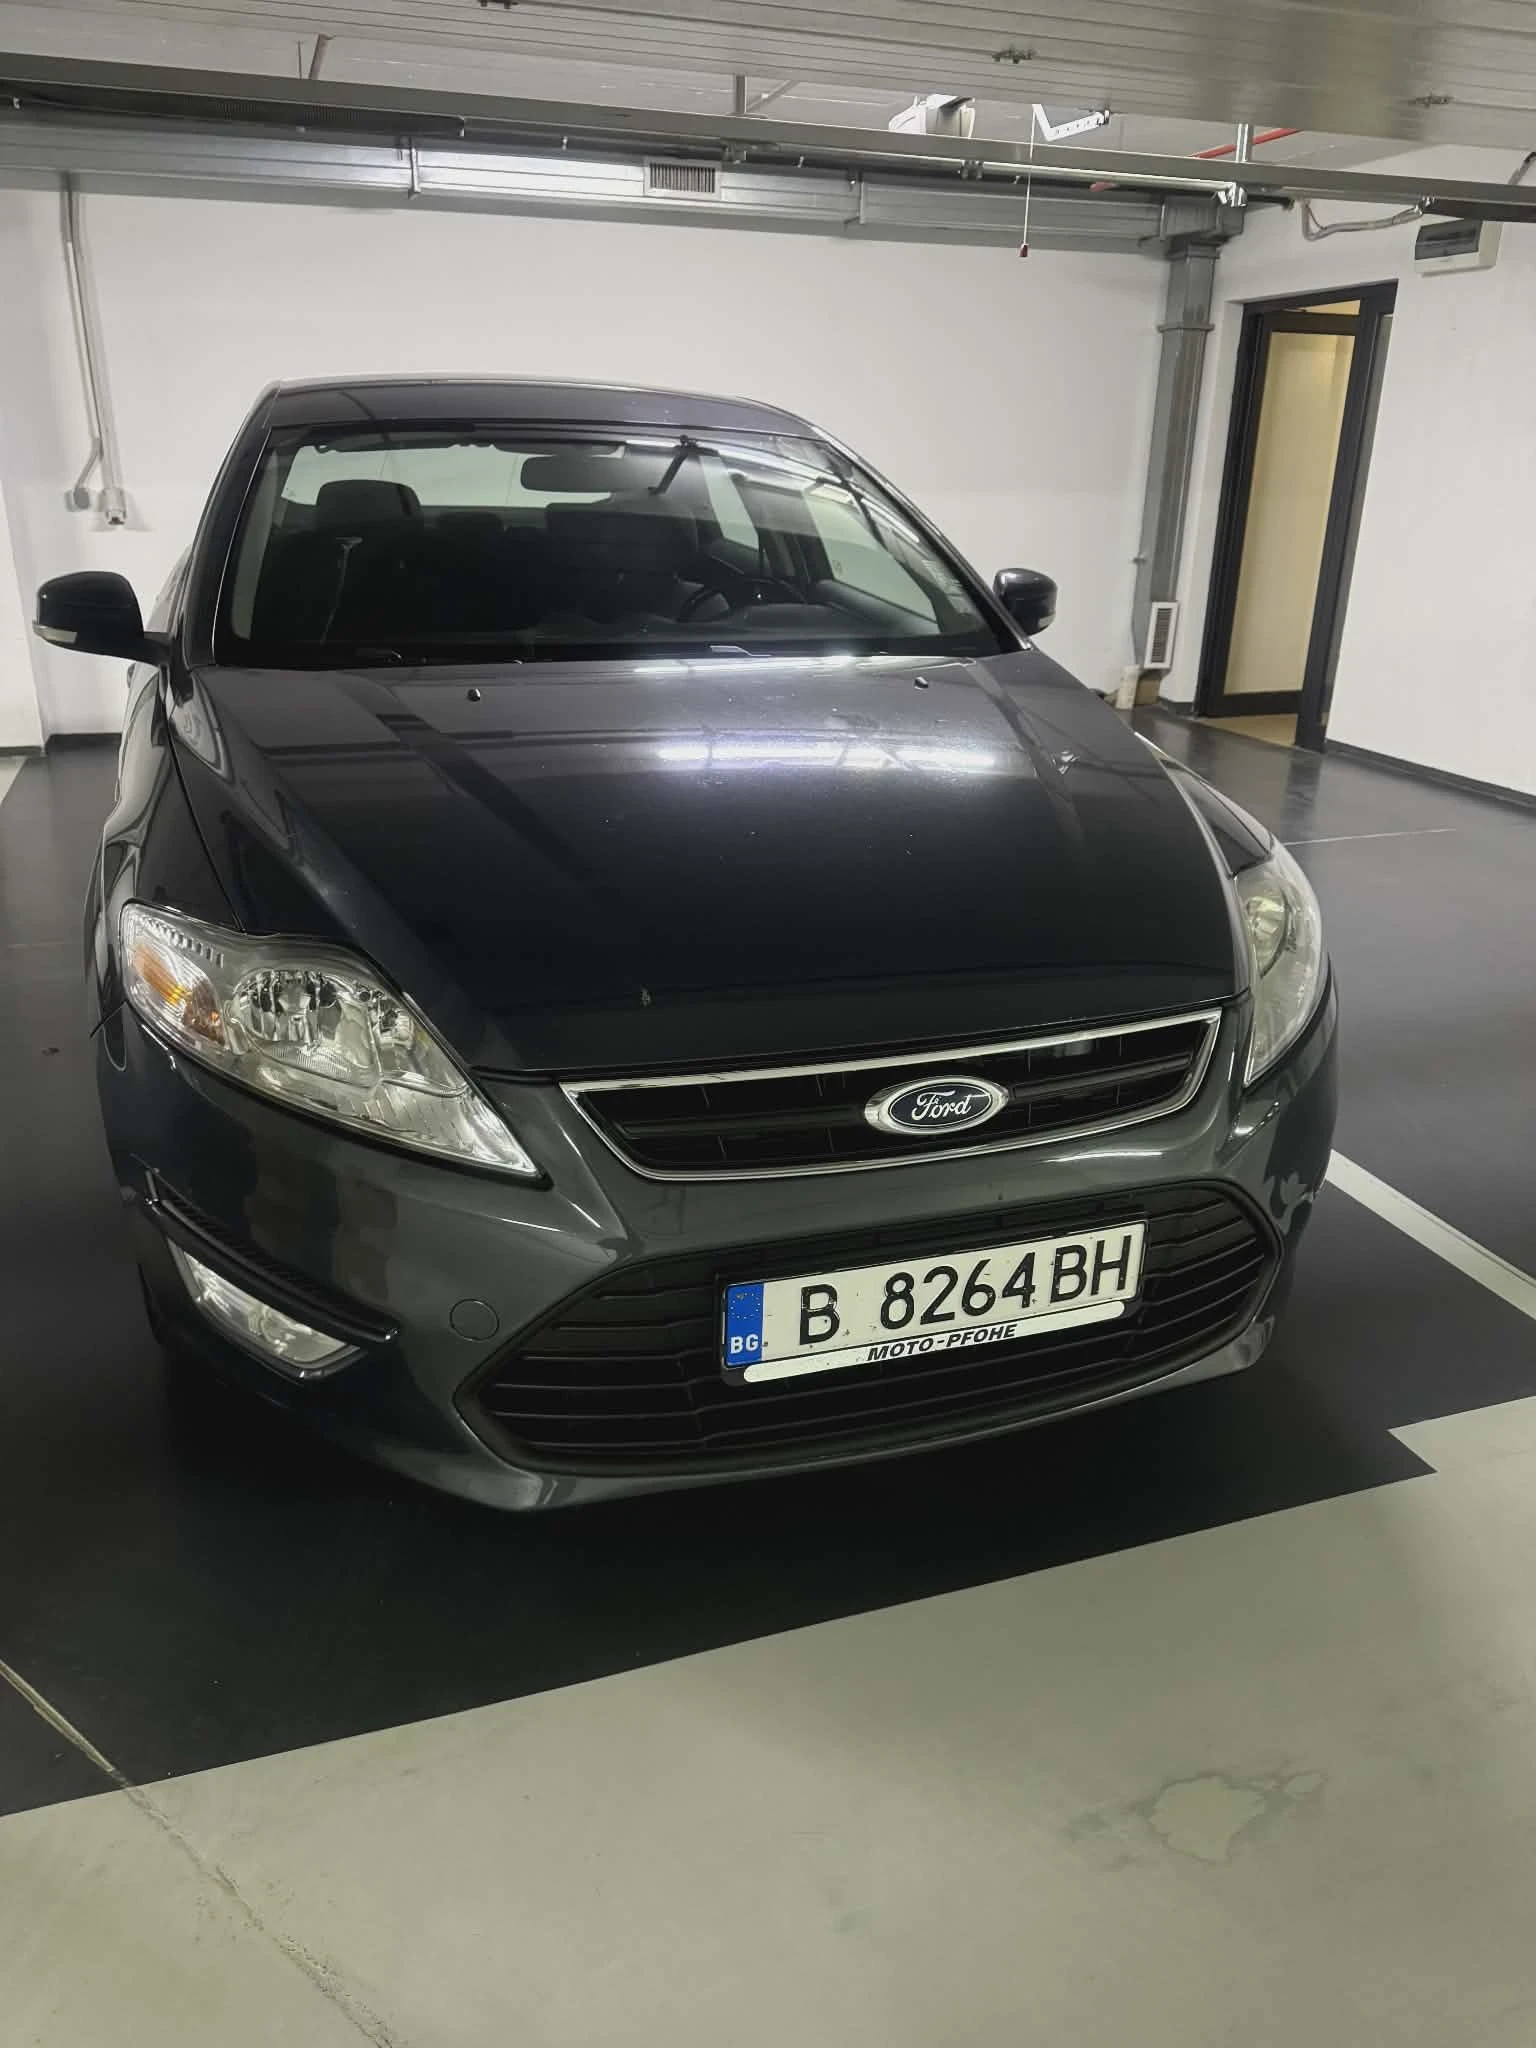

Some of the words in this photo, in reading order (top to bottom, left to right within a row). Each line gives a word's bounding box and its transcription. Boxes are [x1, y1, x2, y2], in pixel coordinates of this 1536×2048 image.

[911, 1090, 978, 1121] Ford
[799, 1283, 841, 1346] B
[880, 1252, 1036, 1330] 8264
[729, 1335, 760, 1355] BG
[866, 1323, 1018, 1361] MOTO-PFOHE
